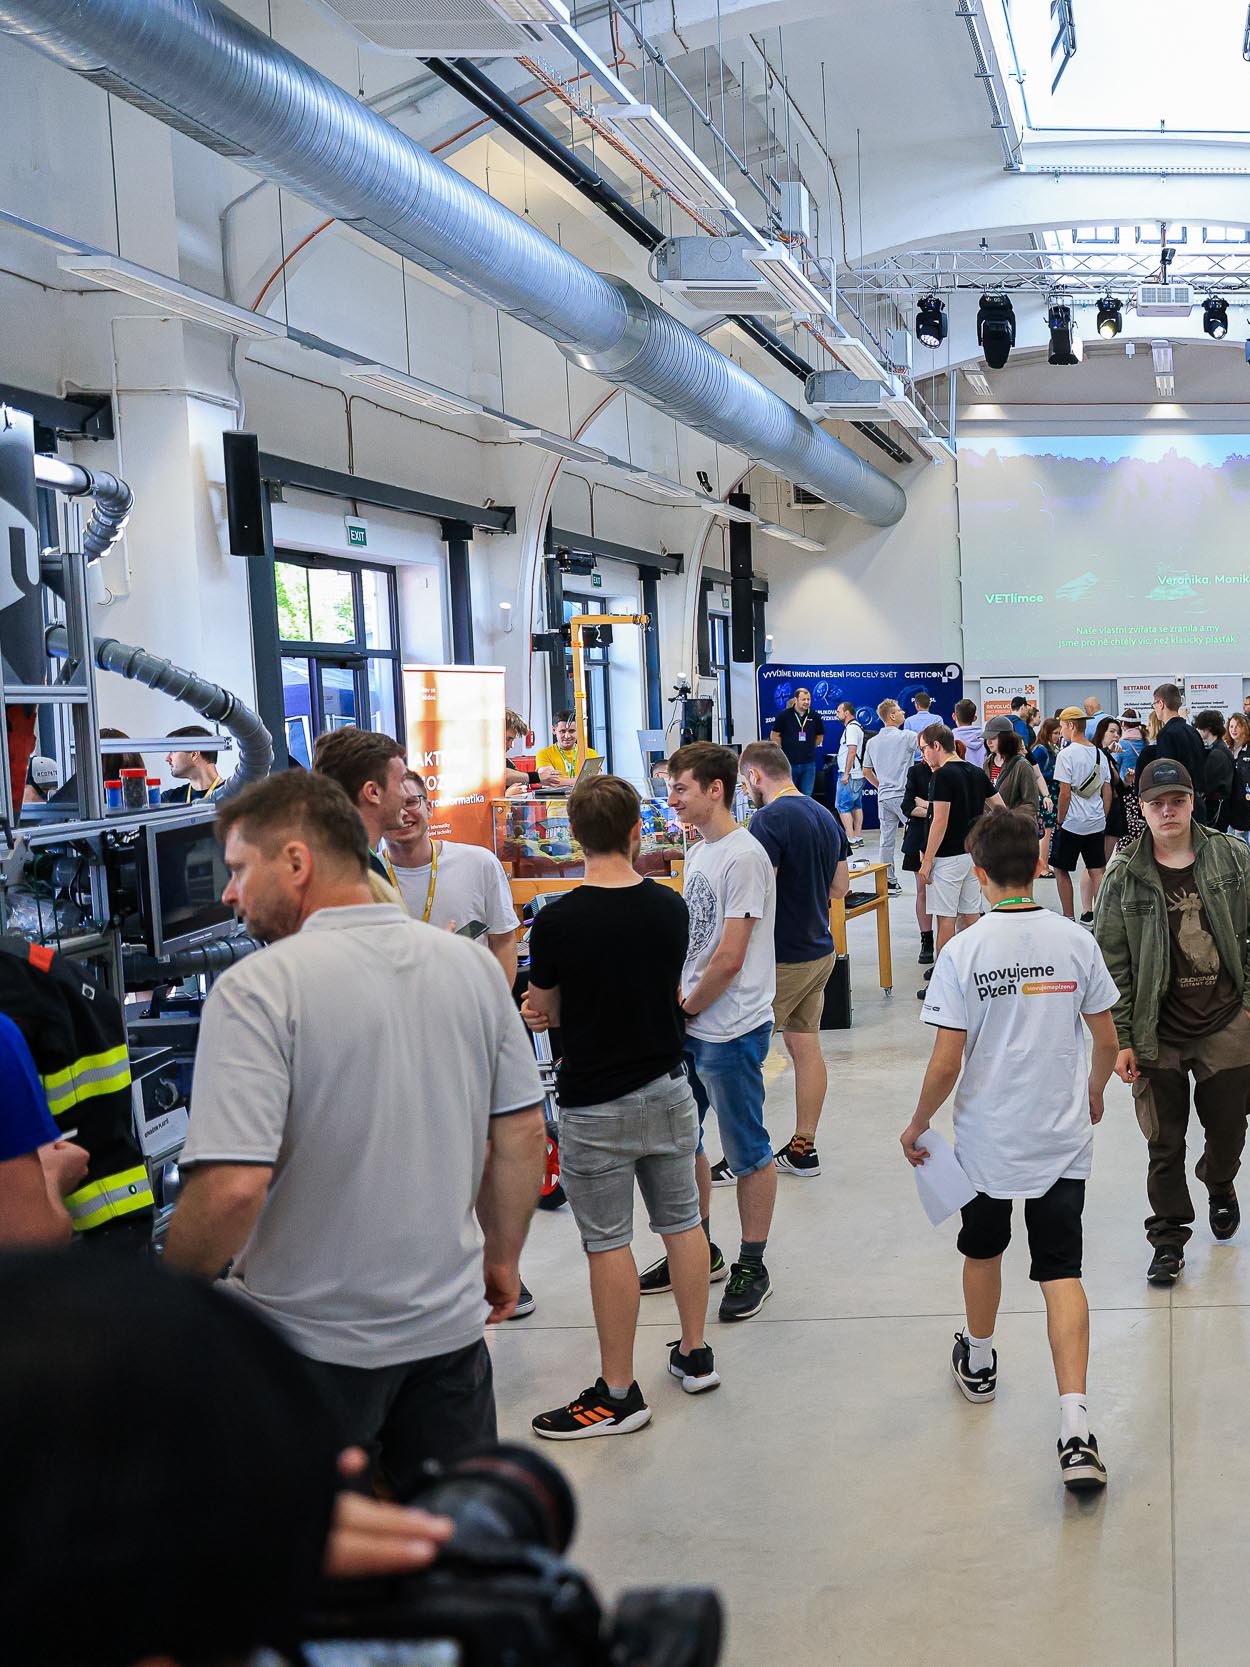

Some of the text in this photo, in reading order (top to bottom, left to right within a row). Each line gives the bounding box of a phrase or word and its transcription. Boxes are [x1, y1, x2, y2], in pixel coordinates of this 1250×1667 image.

[351, 530, 365, 542] EXIT
[1157, 574, 1211, 586] Veronika,
[984, 593, 1044, 604] VETlímce
[1076, 626, 1097, 635] Naše
[1099, 625, 1126, 634] vlastní
[1170, 624, 1197, 633] zranila
[1207, 625, 1220, 633] my
[1057, 639, 1081, 648] jsme
[1081, 639, 1096, 648] pro
[1154, 636, 1169, 644] než
[792, 670, 820, 678] UNIKÁTNÍ
[821, 670, 845, 678] ŘEŠENÍ
[861, 670, 879, 679] CELÝ
[904, 671, 943, 679] CERTICON
[973, 963, 1055, 986] Inovujeme
[977, 980, 1017, 1001] Plzeň
